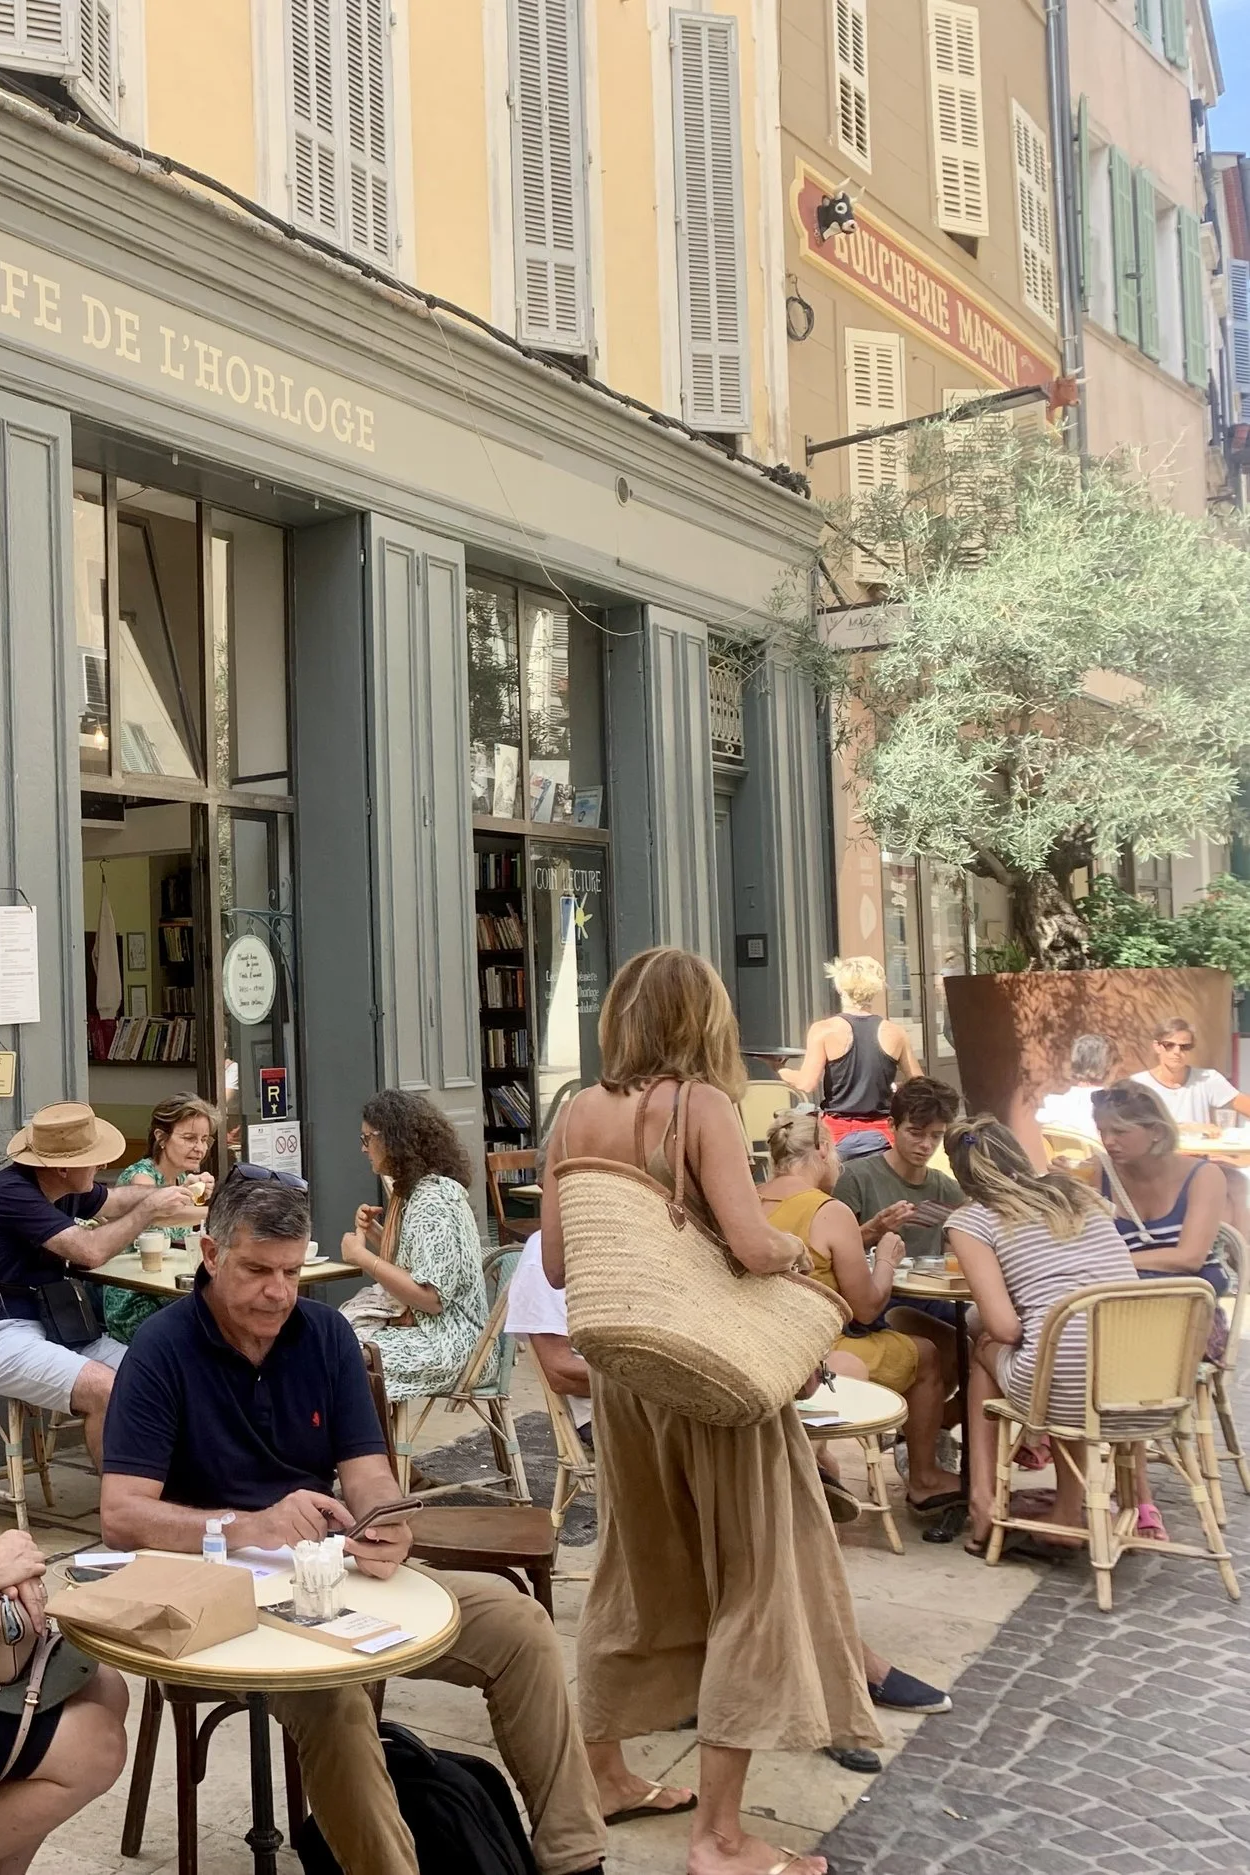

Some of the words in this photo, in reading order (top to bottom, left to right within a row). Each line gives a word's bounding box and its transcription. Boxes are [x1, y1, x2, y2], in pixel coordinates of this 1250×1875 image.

[957, 300, 1019, 386] MARTIN
[82, 294, 141, 363] DE
[160, 325, 376, 452] L'HORLOGE
[535, 867, 558, 890] COIN
[562, 868, 602, 894] LECTURE
[268, 1085, 280, 1102] R
